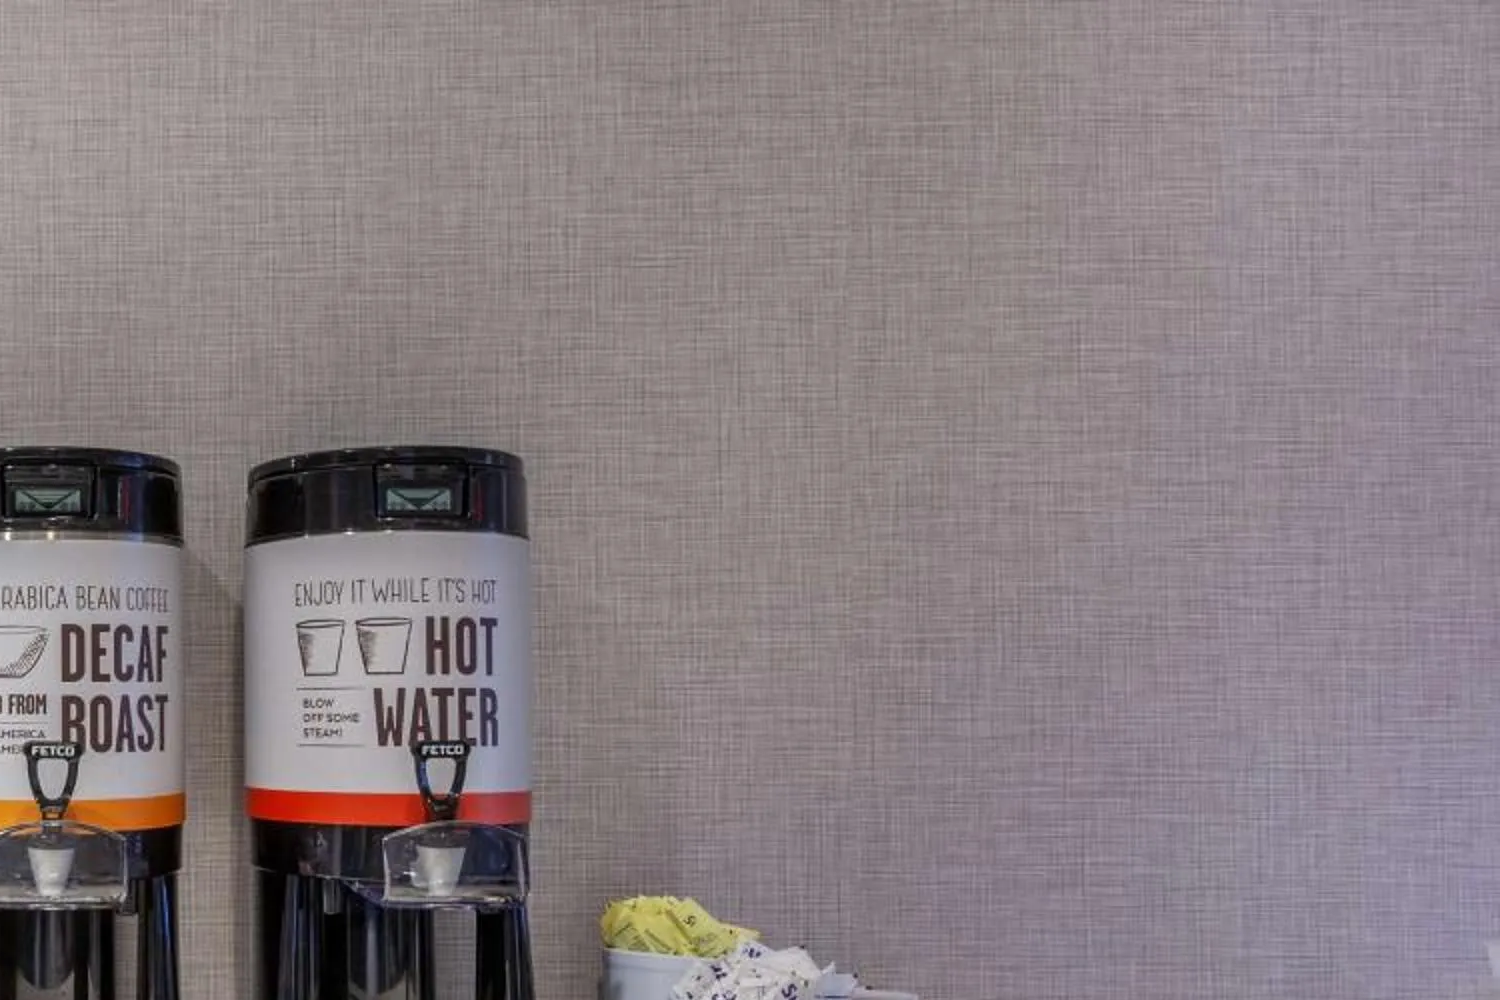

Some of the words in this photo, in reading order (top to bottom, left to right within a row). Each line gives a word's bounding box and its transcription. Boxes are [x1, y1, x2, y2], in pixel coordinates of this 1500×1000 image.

[75, 585, 120, 612] BEAN
[127, 587, 169, 613] COFFEE
[295, 580, 344, 607] ENJOY
[350, 579, 367, 604] IT
[371, 577, 429, 604] WHILE
[438, 578, 466, 604] IT'S
[472, 579, 498, 605] HOT
[61, 623, 169, 683] DECAF
[426, 616, 498, 677] HOT
[8, 693, 47, 715] FROM
[303, 697, 334, 709] BLOW
[373, 687, 499, 747] WATER
[61, 694, 169, 753] ROAST
[303, 712, 323, 723] OFF
[326, 712, 360, 724] SOME
[31, 745, 76, 757] FETCO
[421, 745, 465, 756] FETCO
